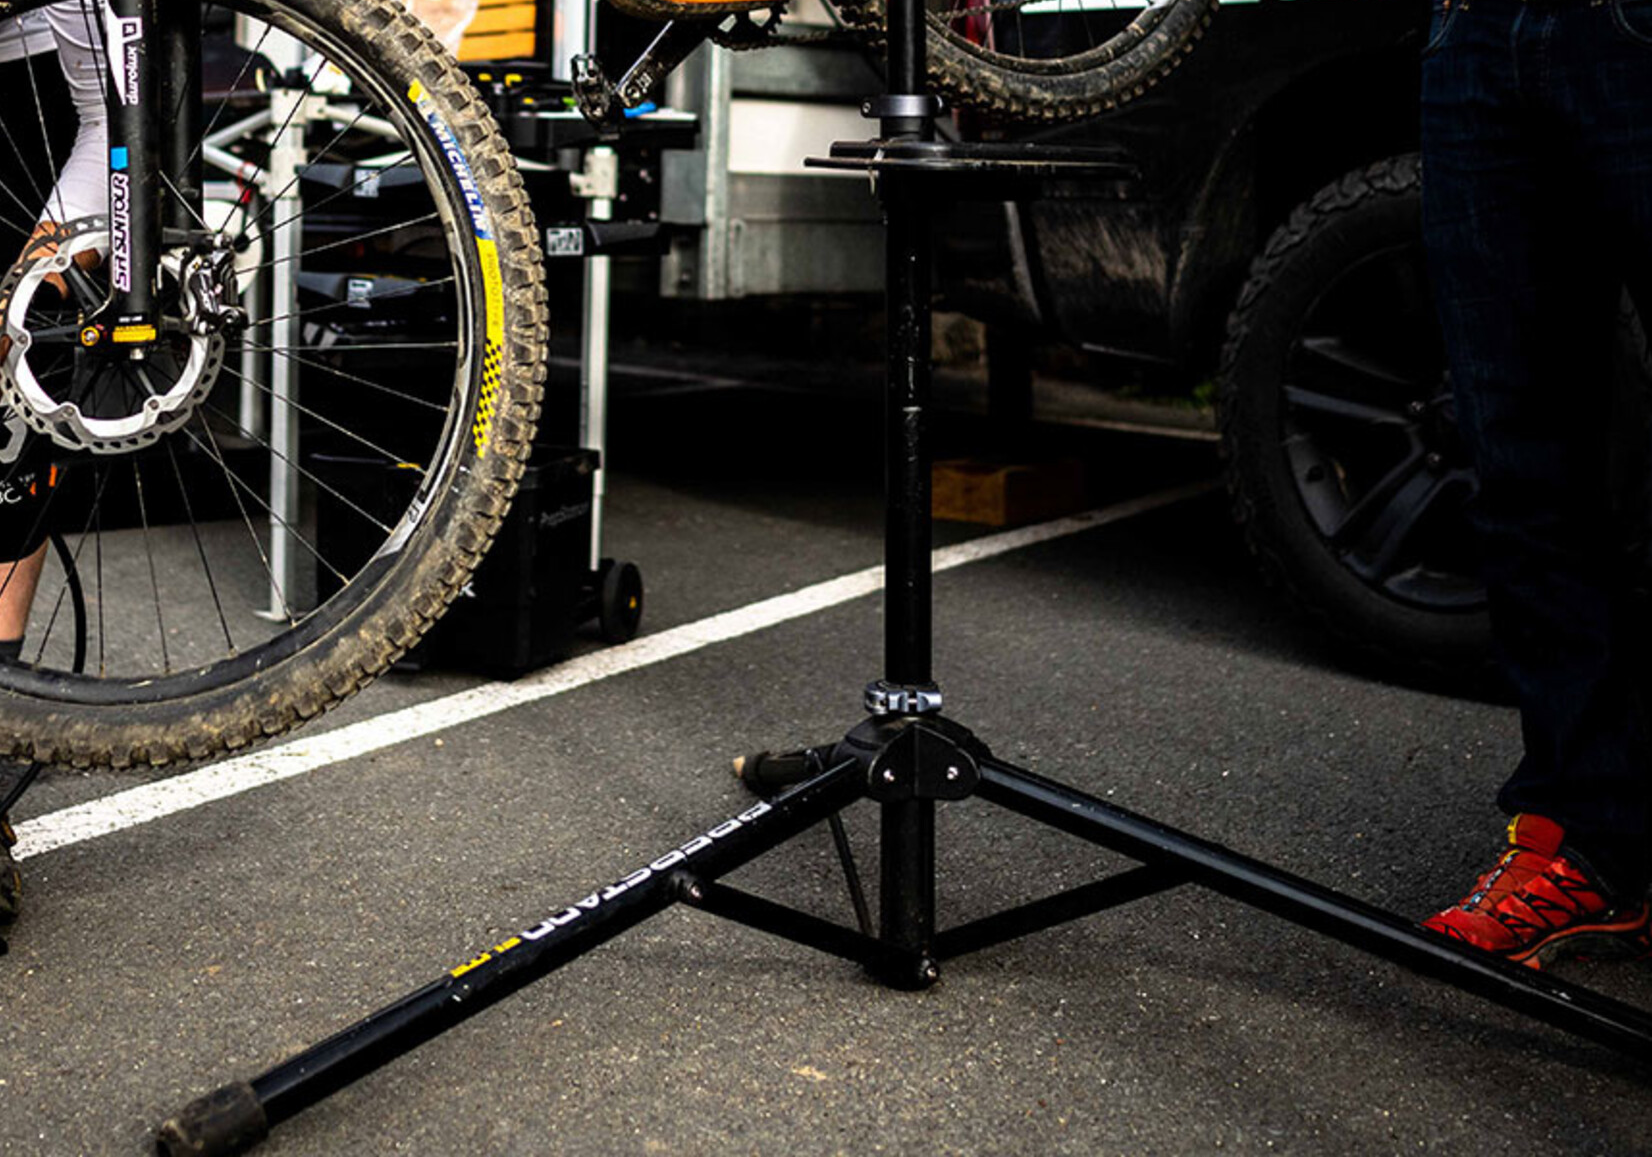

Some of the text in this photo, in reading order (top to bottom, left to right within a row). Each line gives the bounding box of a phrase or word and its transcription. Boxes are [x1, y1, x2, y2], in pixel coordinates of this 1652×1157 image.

[125, 45, 139, 105] durolux
[112, 173, 129, 254] SUNTOUR
[430, 119, 491, 231] MICHELIN
